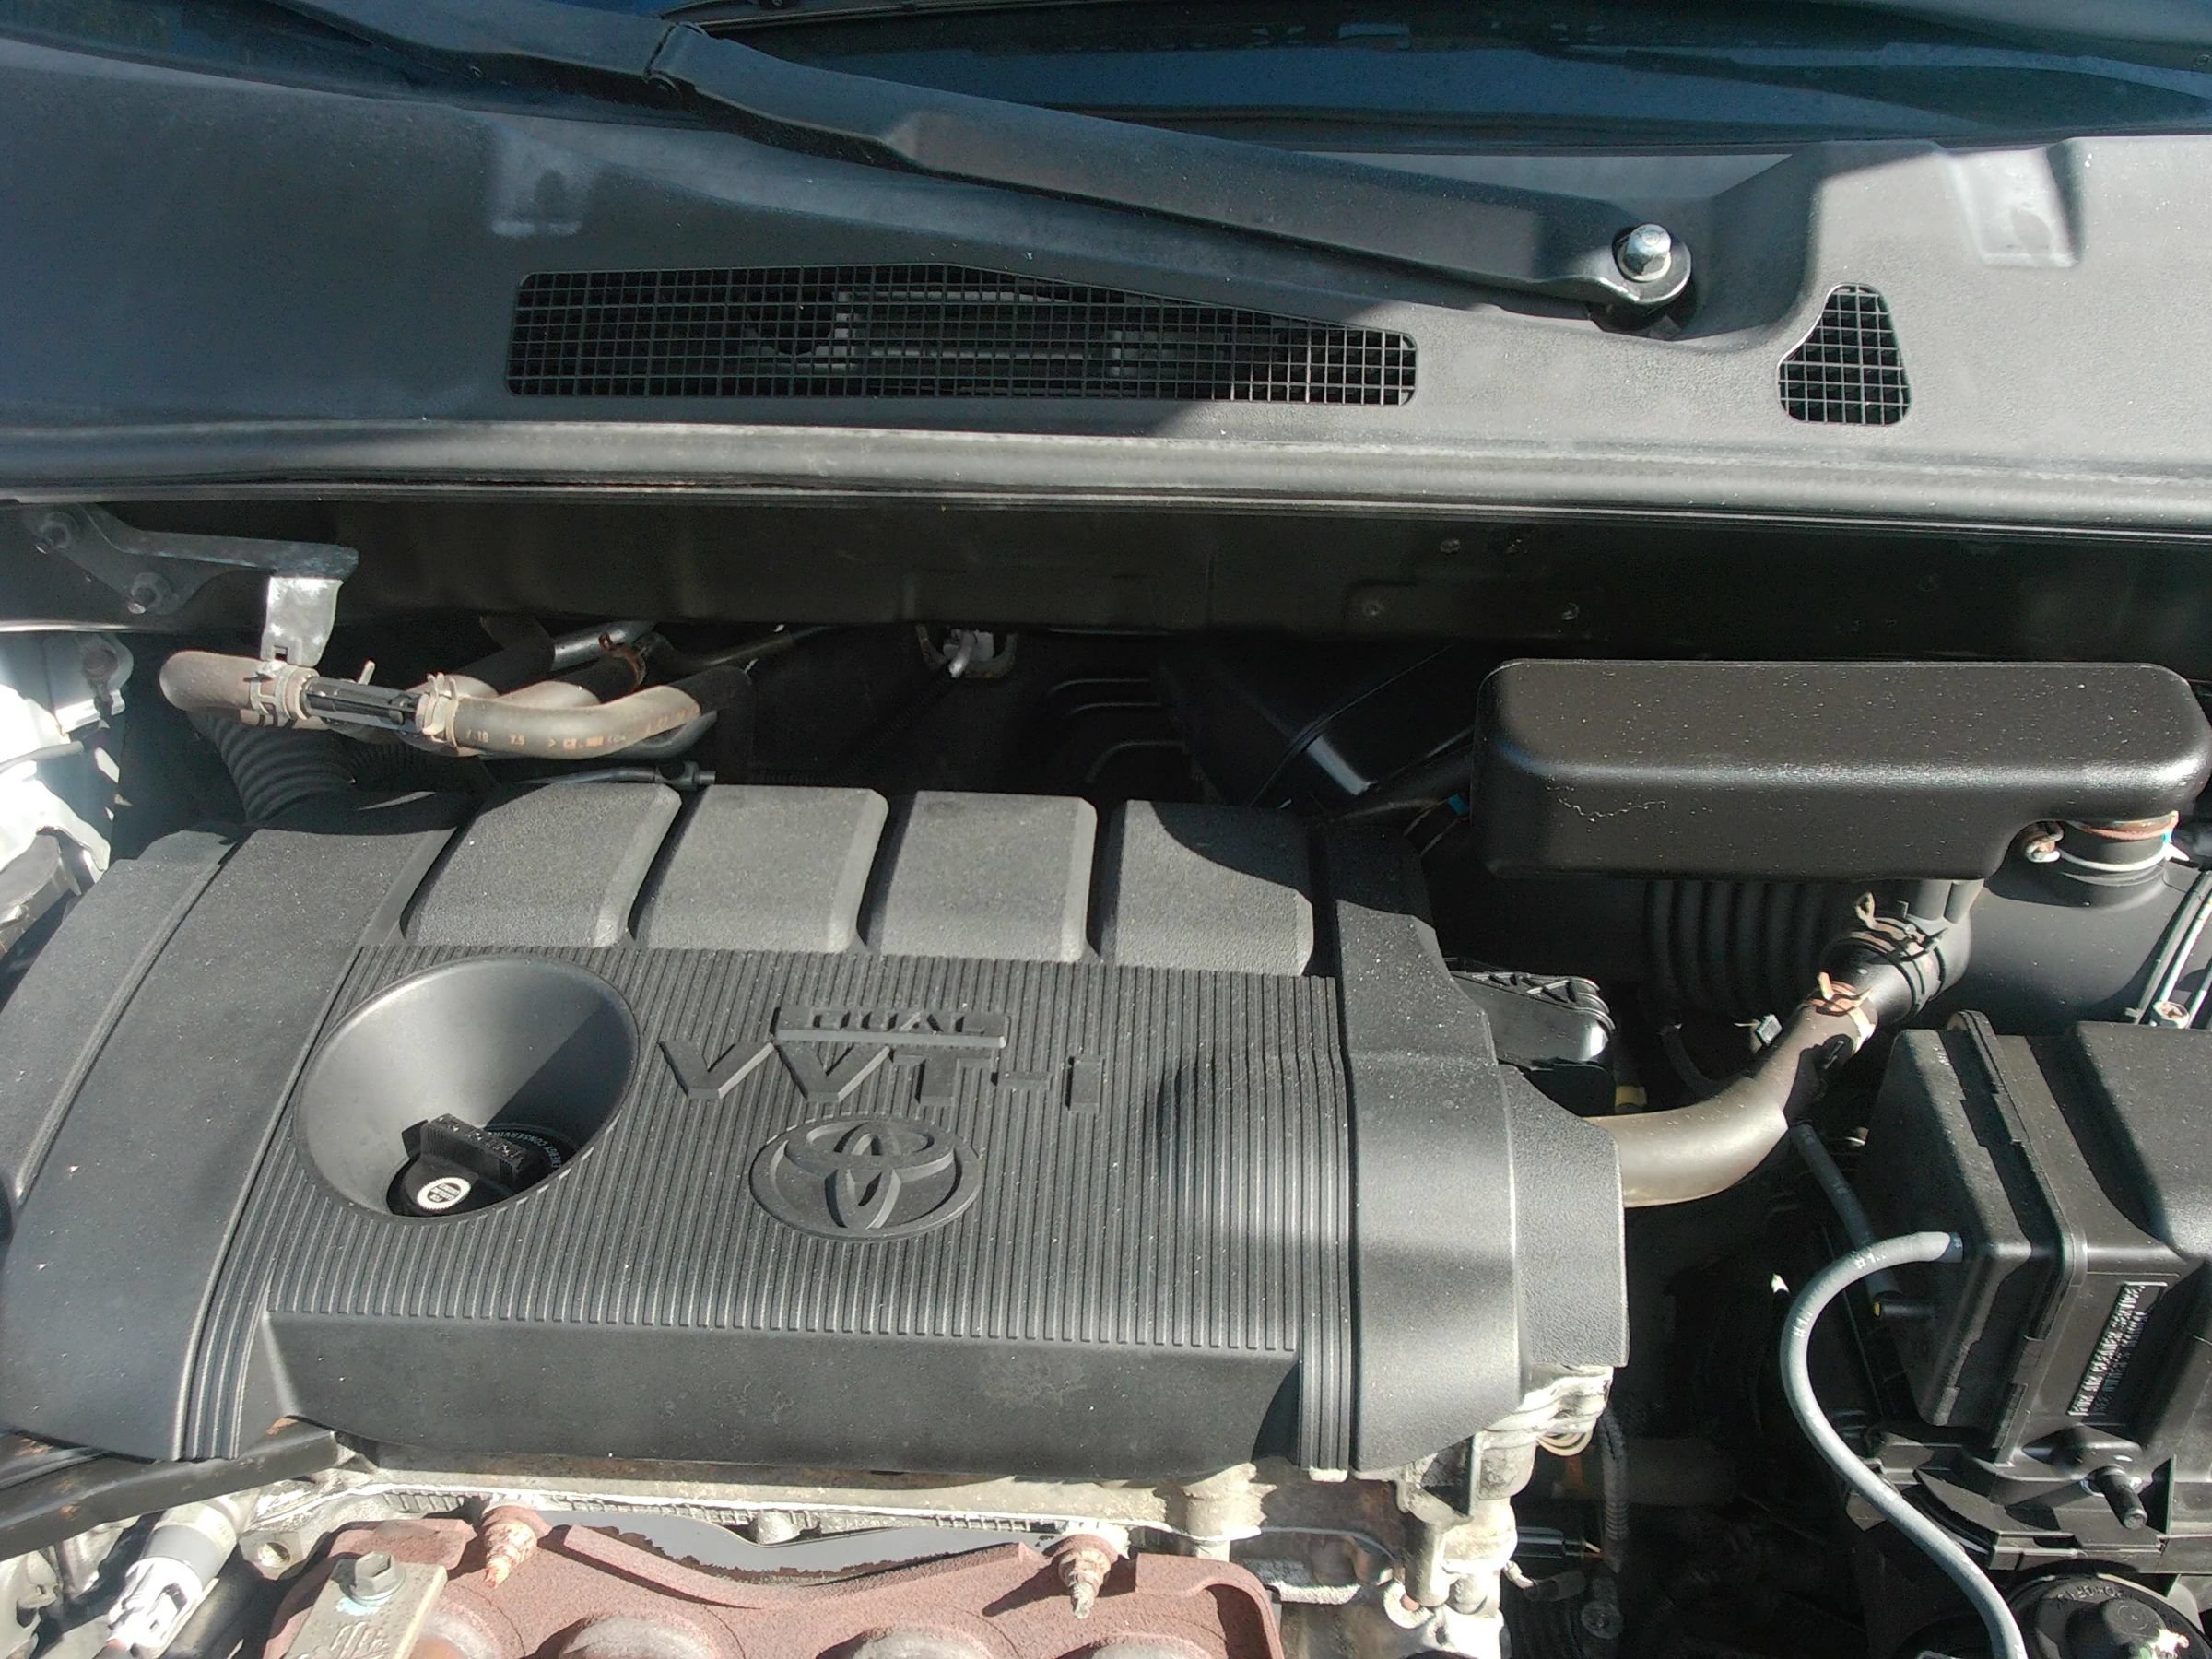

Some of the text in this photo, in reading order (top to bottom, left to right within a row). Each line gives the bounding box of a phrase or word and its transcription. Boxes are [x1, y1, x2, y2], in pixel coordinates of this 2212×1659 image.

[807, 1010, 987, 1034] DUAL
[491, 1130, 548, 1149] CONSERVIN
[545, 1145, 563, 1169] NERGY
